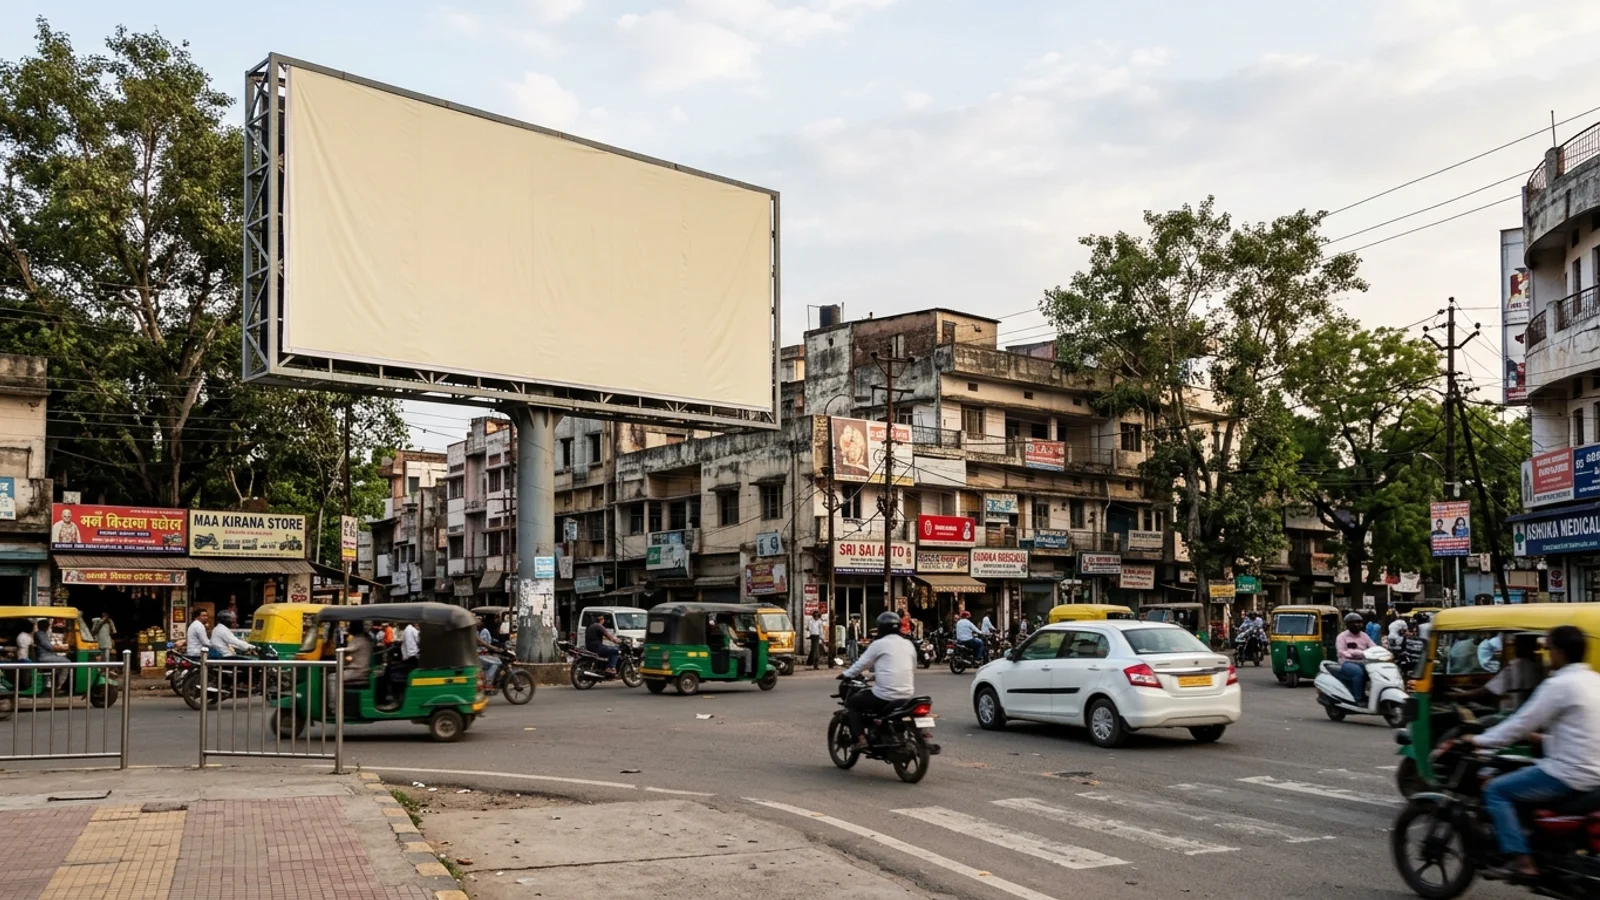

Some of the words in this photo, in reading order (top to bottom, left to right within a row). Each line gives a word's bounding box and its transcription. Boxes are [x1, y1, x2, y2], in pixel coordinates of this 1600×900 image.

[194, 514, 219, 527] MAA
[222, 515, 265, 529] KIRANA
[267, 517, 303, 530] STORE
[1560, 516, 1600, 537] MEDICAL
[839, 543, 856, 556] SRI
[859, 544, 875, 556] SAI
[877, 545, 904, 557] ATO
